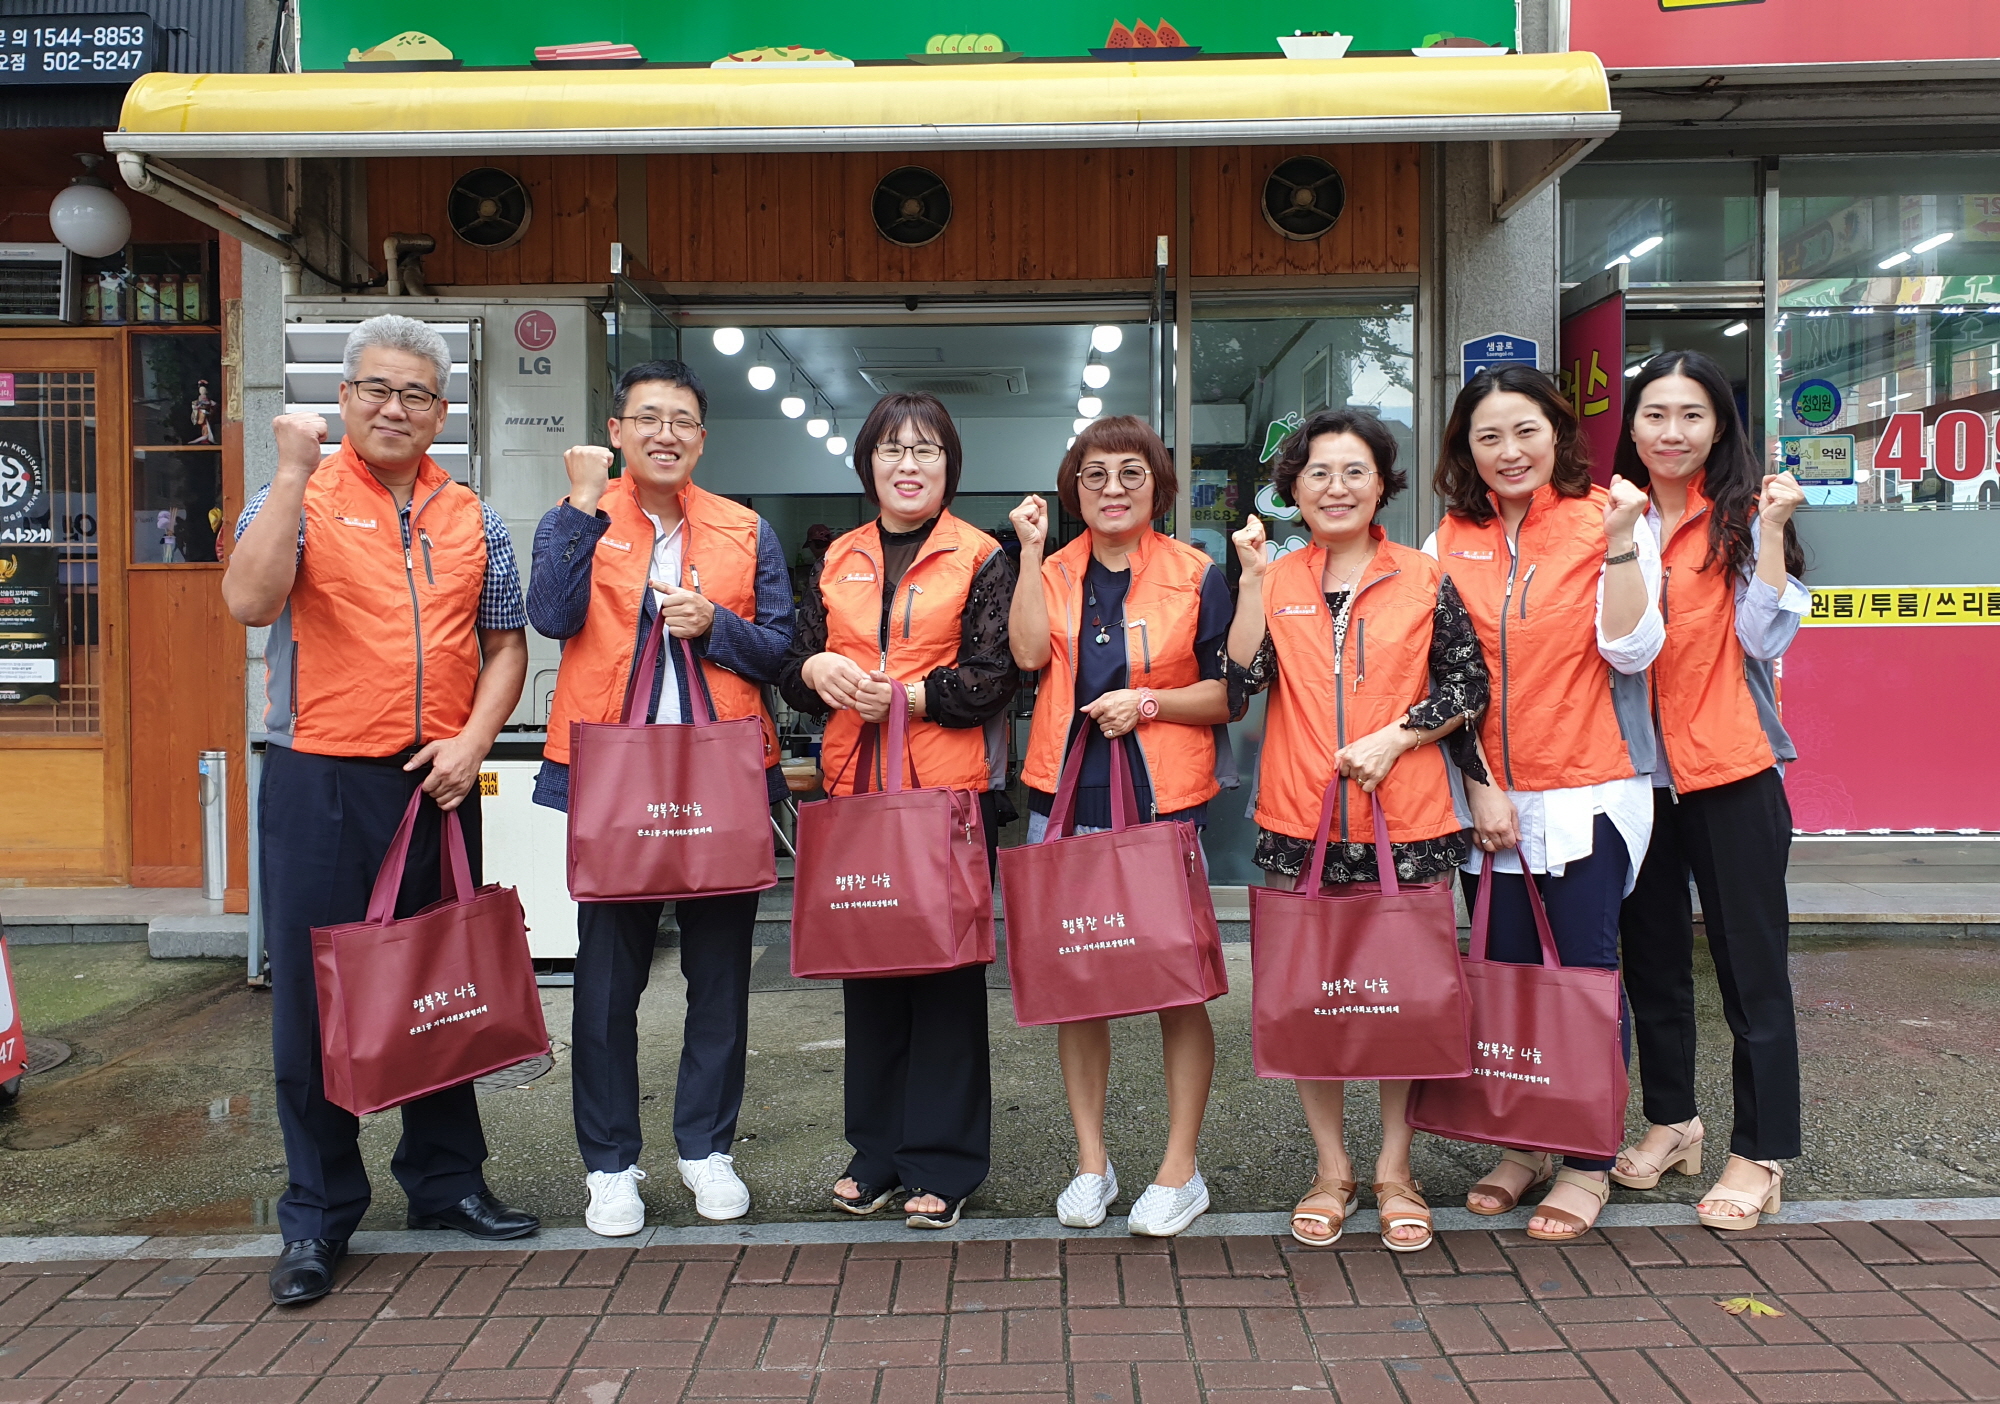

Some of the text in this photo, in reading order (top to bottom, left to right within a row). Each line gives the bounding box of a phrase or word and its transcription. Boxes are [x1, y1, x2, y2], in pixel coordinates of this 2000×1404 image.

[33, 26, 144, 47] 1544-8853
[43, 51, 142, 71] 502-5247
[1486, 341, 1514, 352] 샘골로
[519, 357, 551, 375] LG
[1802, 394, 1831, 412] 정회원
[505, 417, 548, 425] MULTI
[1873, 410, 2000, 482] 40
[11, 443, 42, 486] KKOJISAKKE
[682, 801, 703, 817] 나눔
[871, 872, 891, 888] 나눔
[1103, 912, 1125, 928] 나눔
[454, 982, 477, 999] 나눔
[1364, 977, 1389, 994] 나눔
[1520, 1047, 1542, 1065] 나눔
[1471, 1067, 1492, 1077] 오1동
